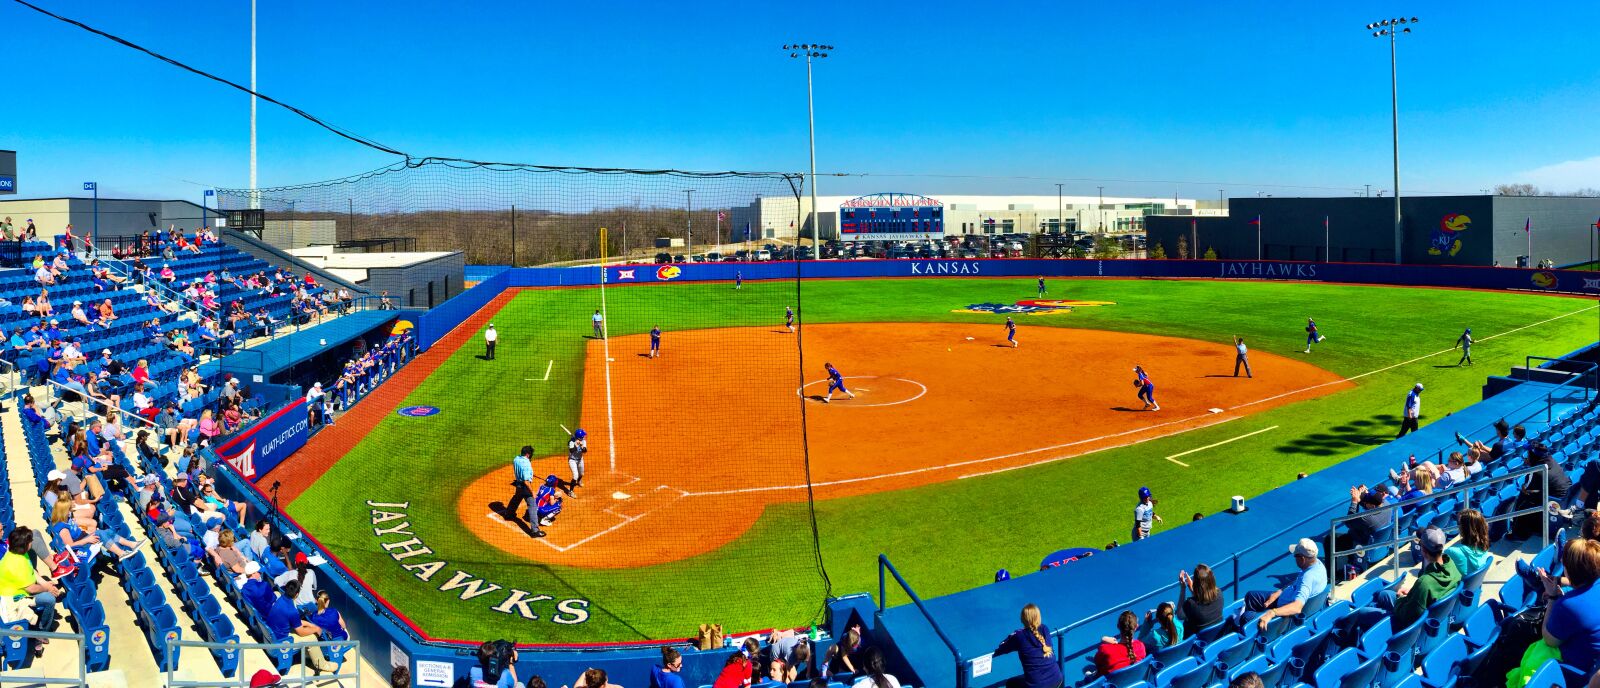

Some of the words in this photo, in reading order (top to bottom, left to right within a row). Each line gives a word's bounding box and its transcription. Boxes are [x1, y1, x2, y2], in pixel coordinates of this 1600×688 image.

[911, 261, 979, 274] KANSAS
[1220, 262, 1316, 277] JAYHAWKS
[366, 500, 590, 624] JAYHAWKS
